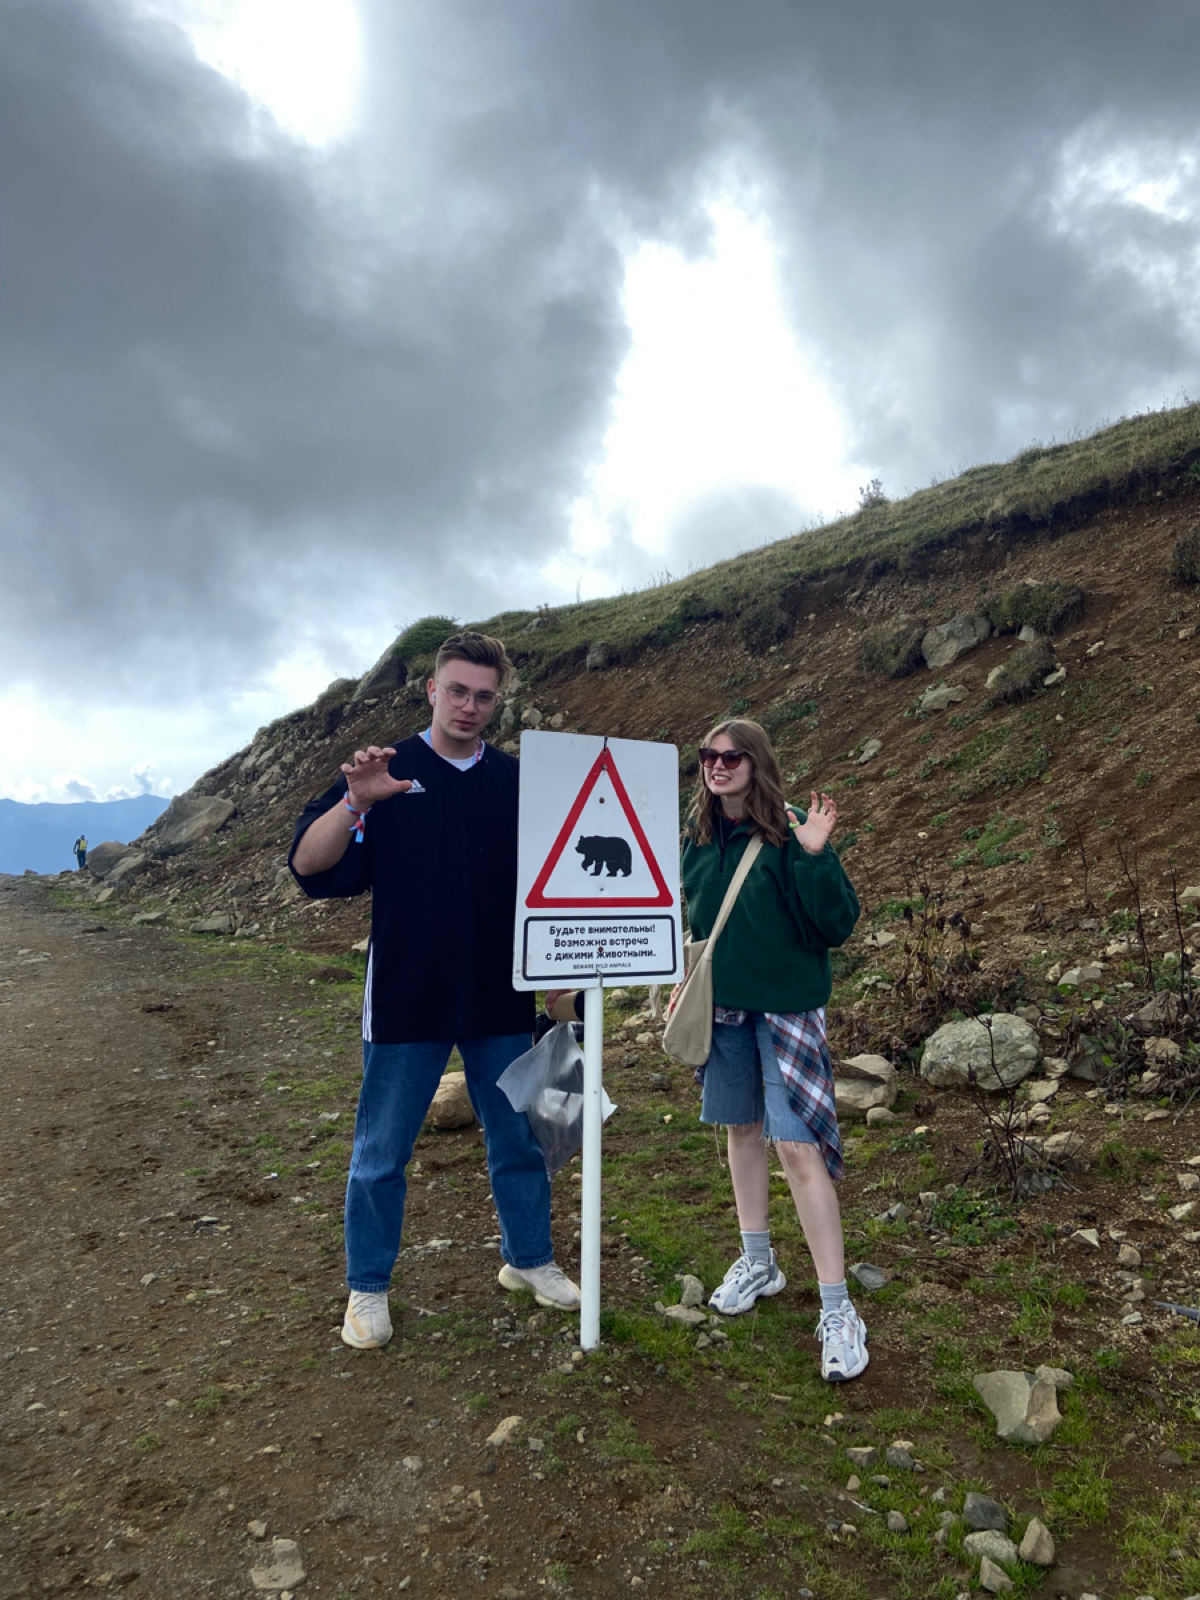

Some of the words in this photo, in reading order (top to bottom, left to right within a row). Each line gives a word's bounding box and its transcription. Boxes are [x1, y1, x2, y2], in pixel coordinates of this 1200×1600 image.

[549, 925, 586, 937] Будьте
[588, 923, 656, 934] внимательны!
[554, 938, 607, 947] Возможна
[609, 937, 649, 948] встреча
[545, 952, 552, 960] с
[554, 952, 593, 961] дикими
[596, 949, 657, 959] животными.
